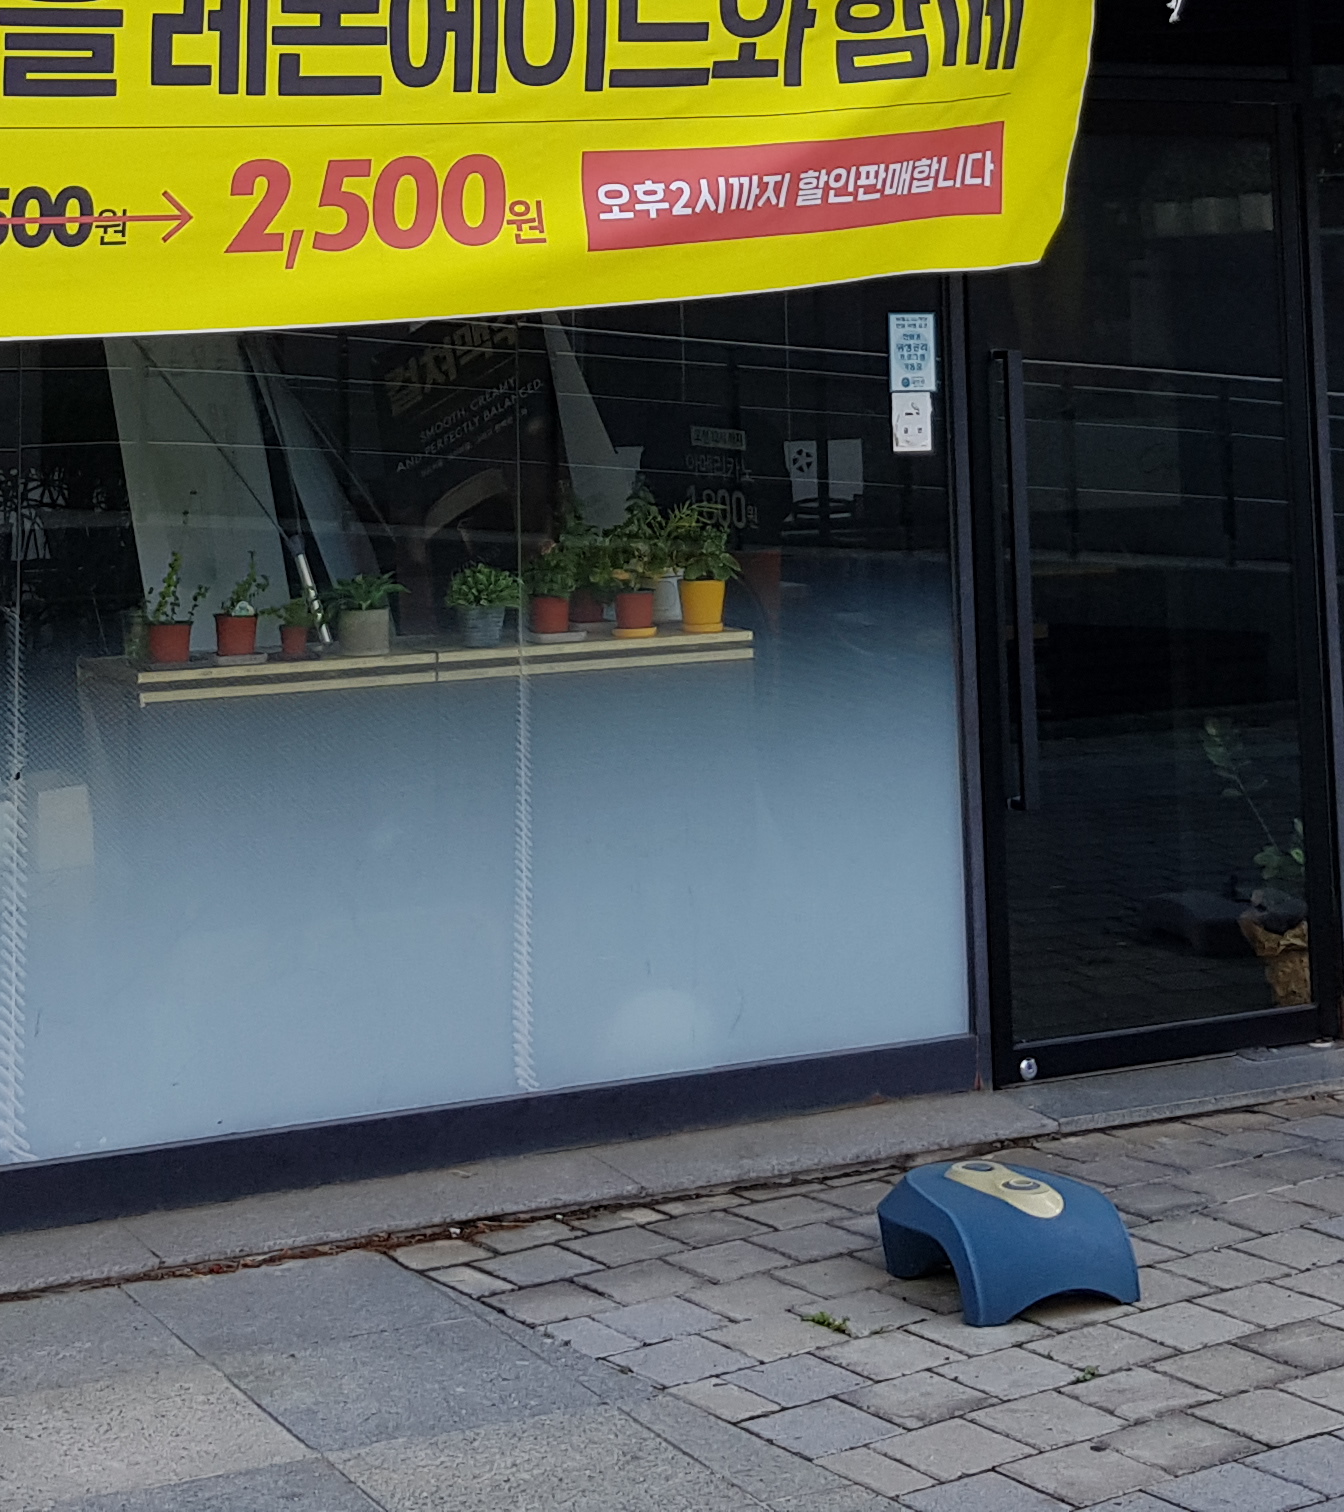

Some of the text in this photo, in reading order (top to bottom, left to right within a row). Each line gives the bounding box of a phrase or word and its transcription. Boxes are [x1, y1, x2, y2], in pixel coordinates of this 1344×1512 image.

[222, 153, 549, 271] 2,500원
[597, 149, 996, 221] 오후2시까지 할인판매합니다
